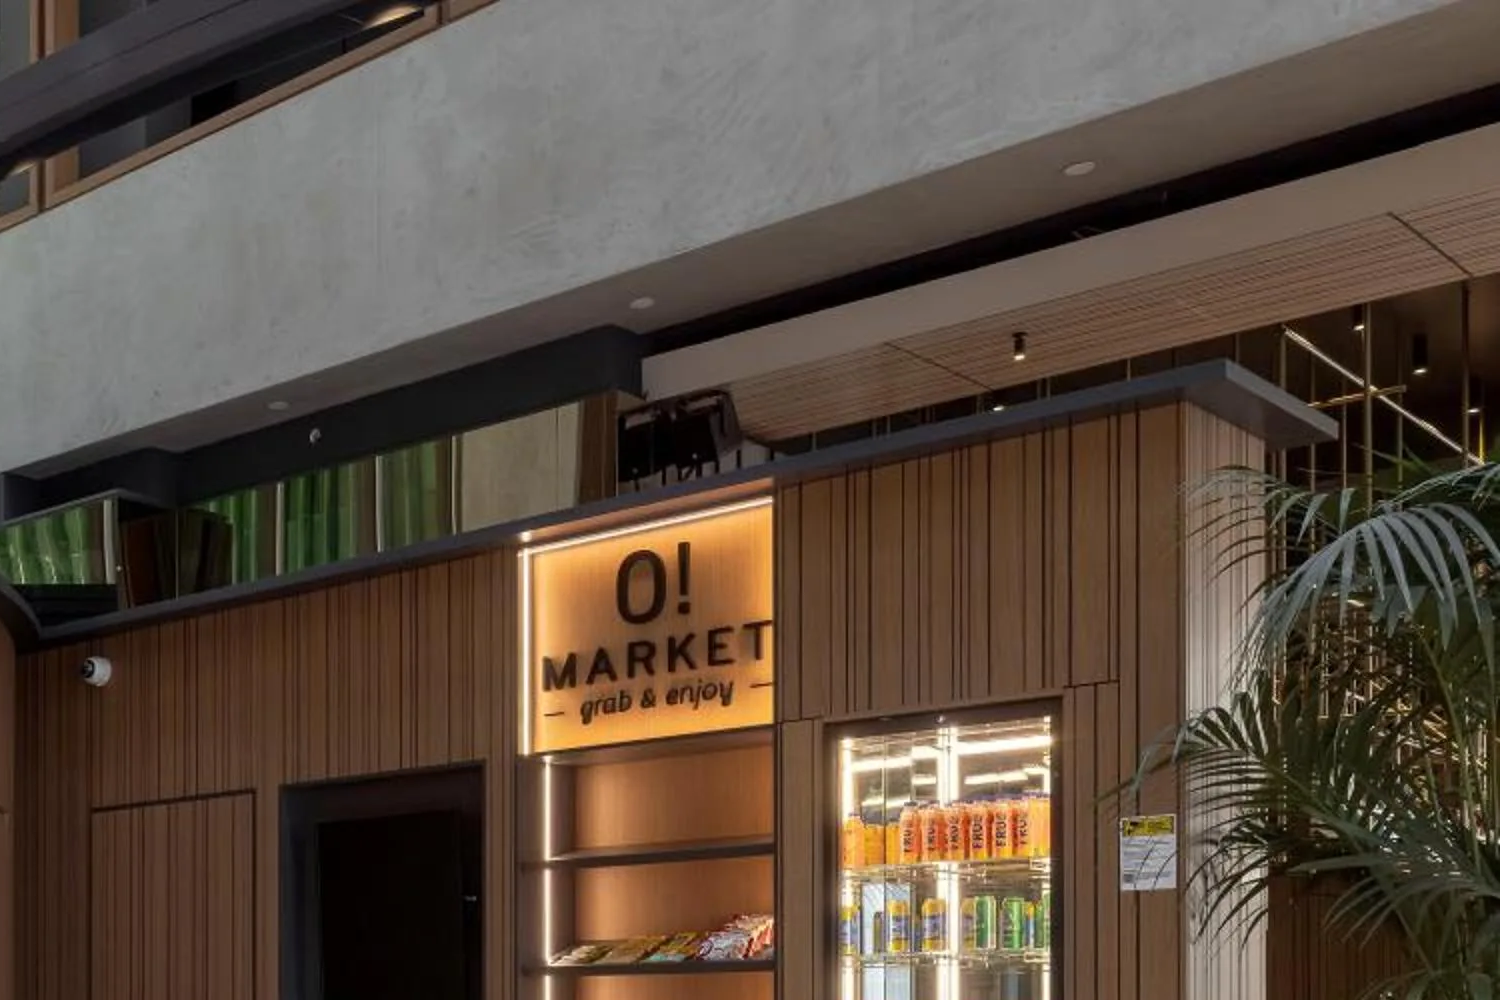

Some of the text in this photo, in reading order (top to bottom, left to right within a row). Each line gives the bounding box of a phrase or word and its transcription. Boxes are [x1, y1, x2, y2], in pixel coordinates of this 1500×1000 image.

[616, 541, 691, 625] O!
[541, 619, 774, 692] MARKET
[580, 680, 735, 725] grab & enjoy
